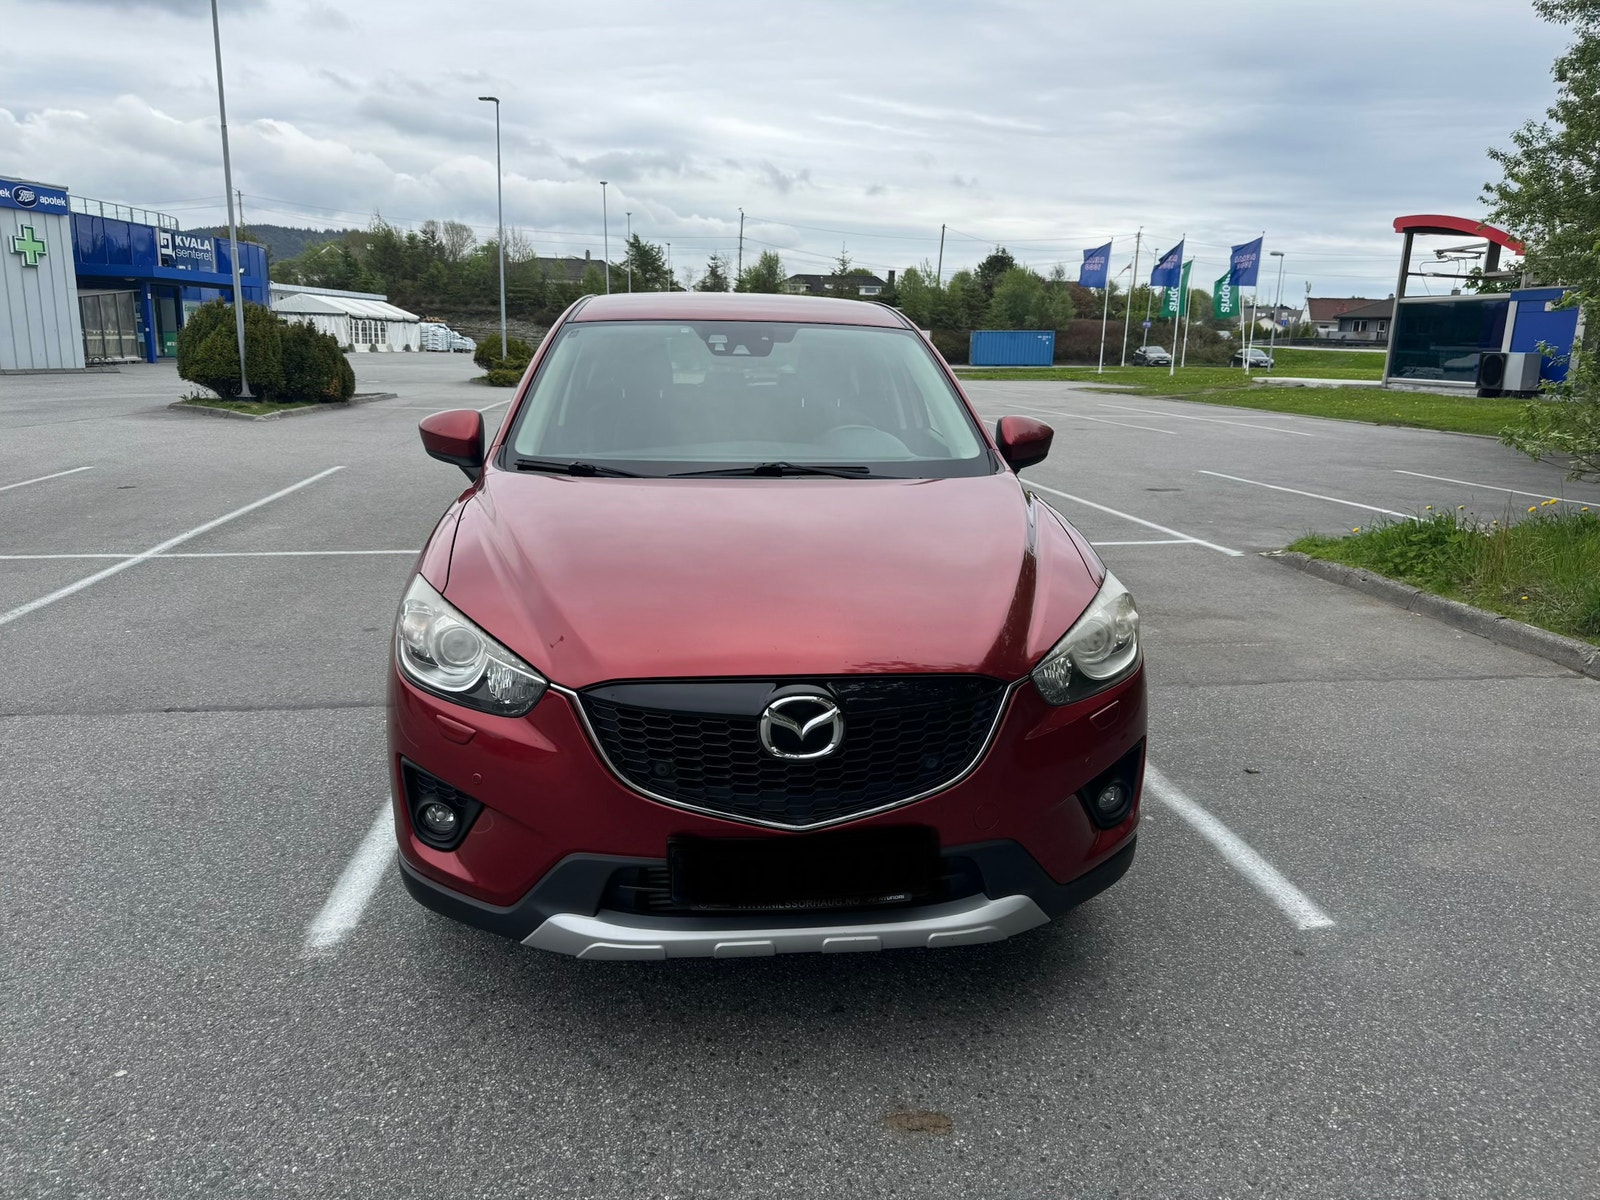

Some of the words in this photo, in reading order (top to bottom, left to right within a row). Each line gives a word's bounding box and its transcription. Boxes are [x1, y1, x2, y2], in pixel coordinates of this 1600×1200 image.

[0, 188, 11, 198] ek
[39, 195, 67, 206] apotek
[175, 235, 211, 251] KVALA
[175, 248, 212, 261] senteret
